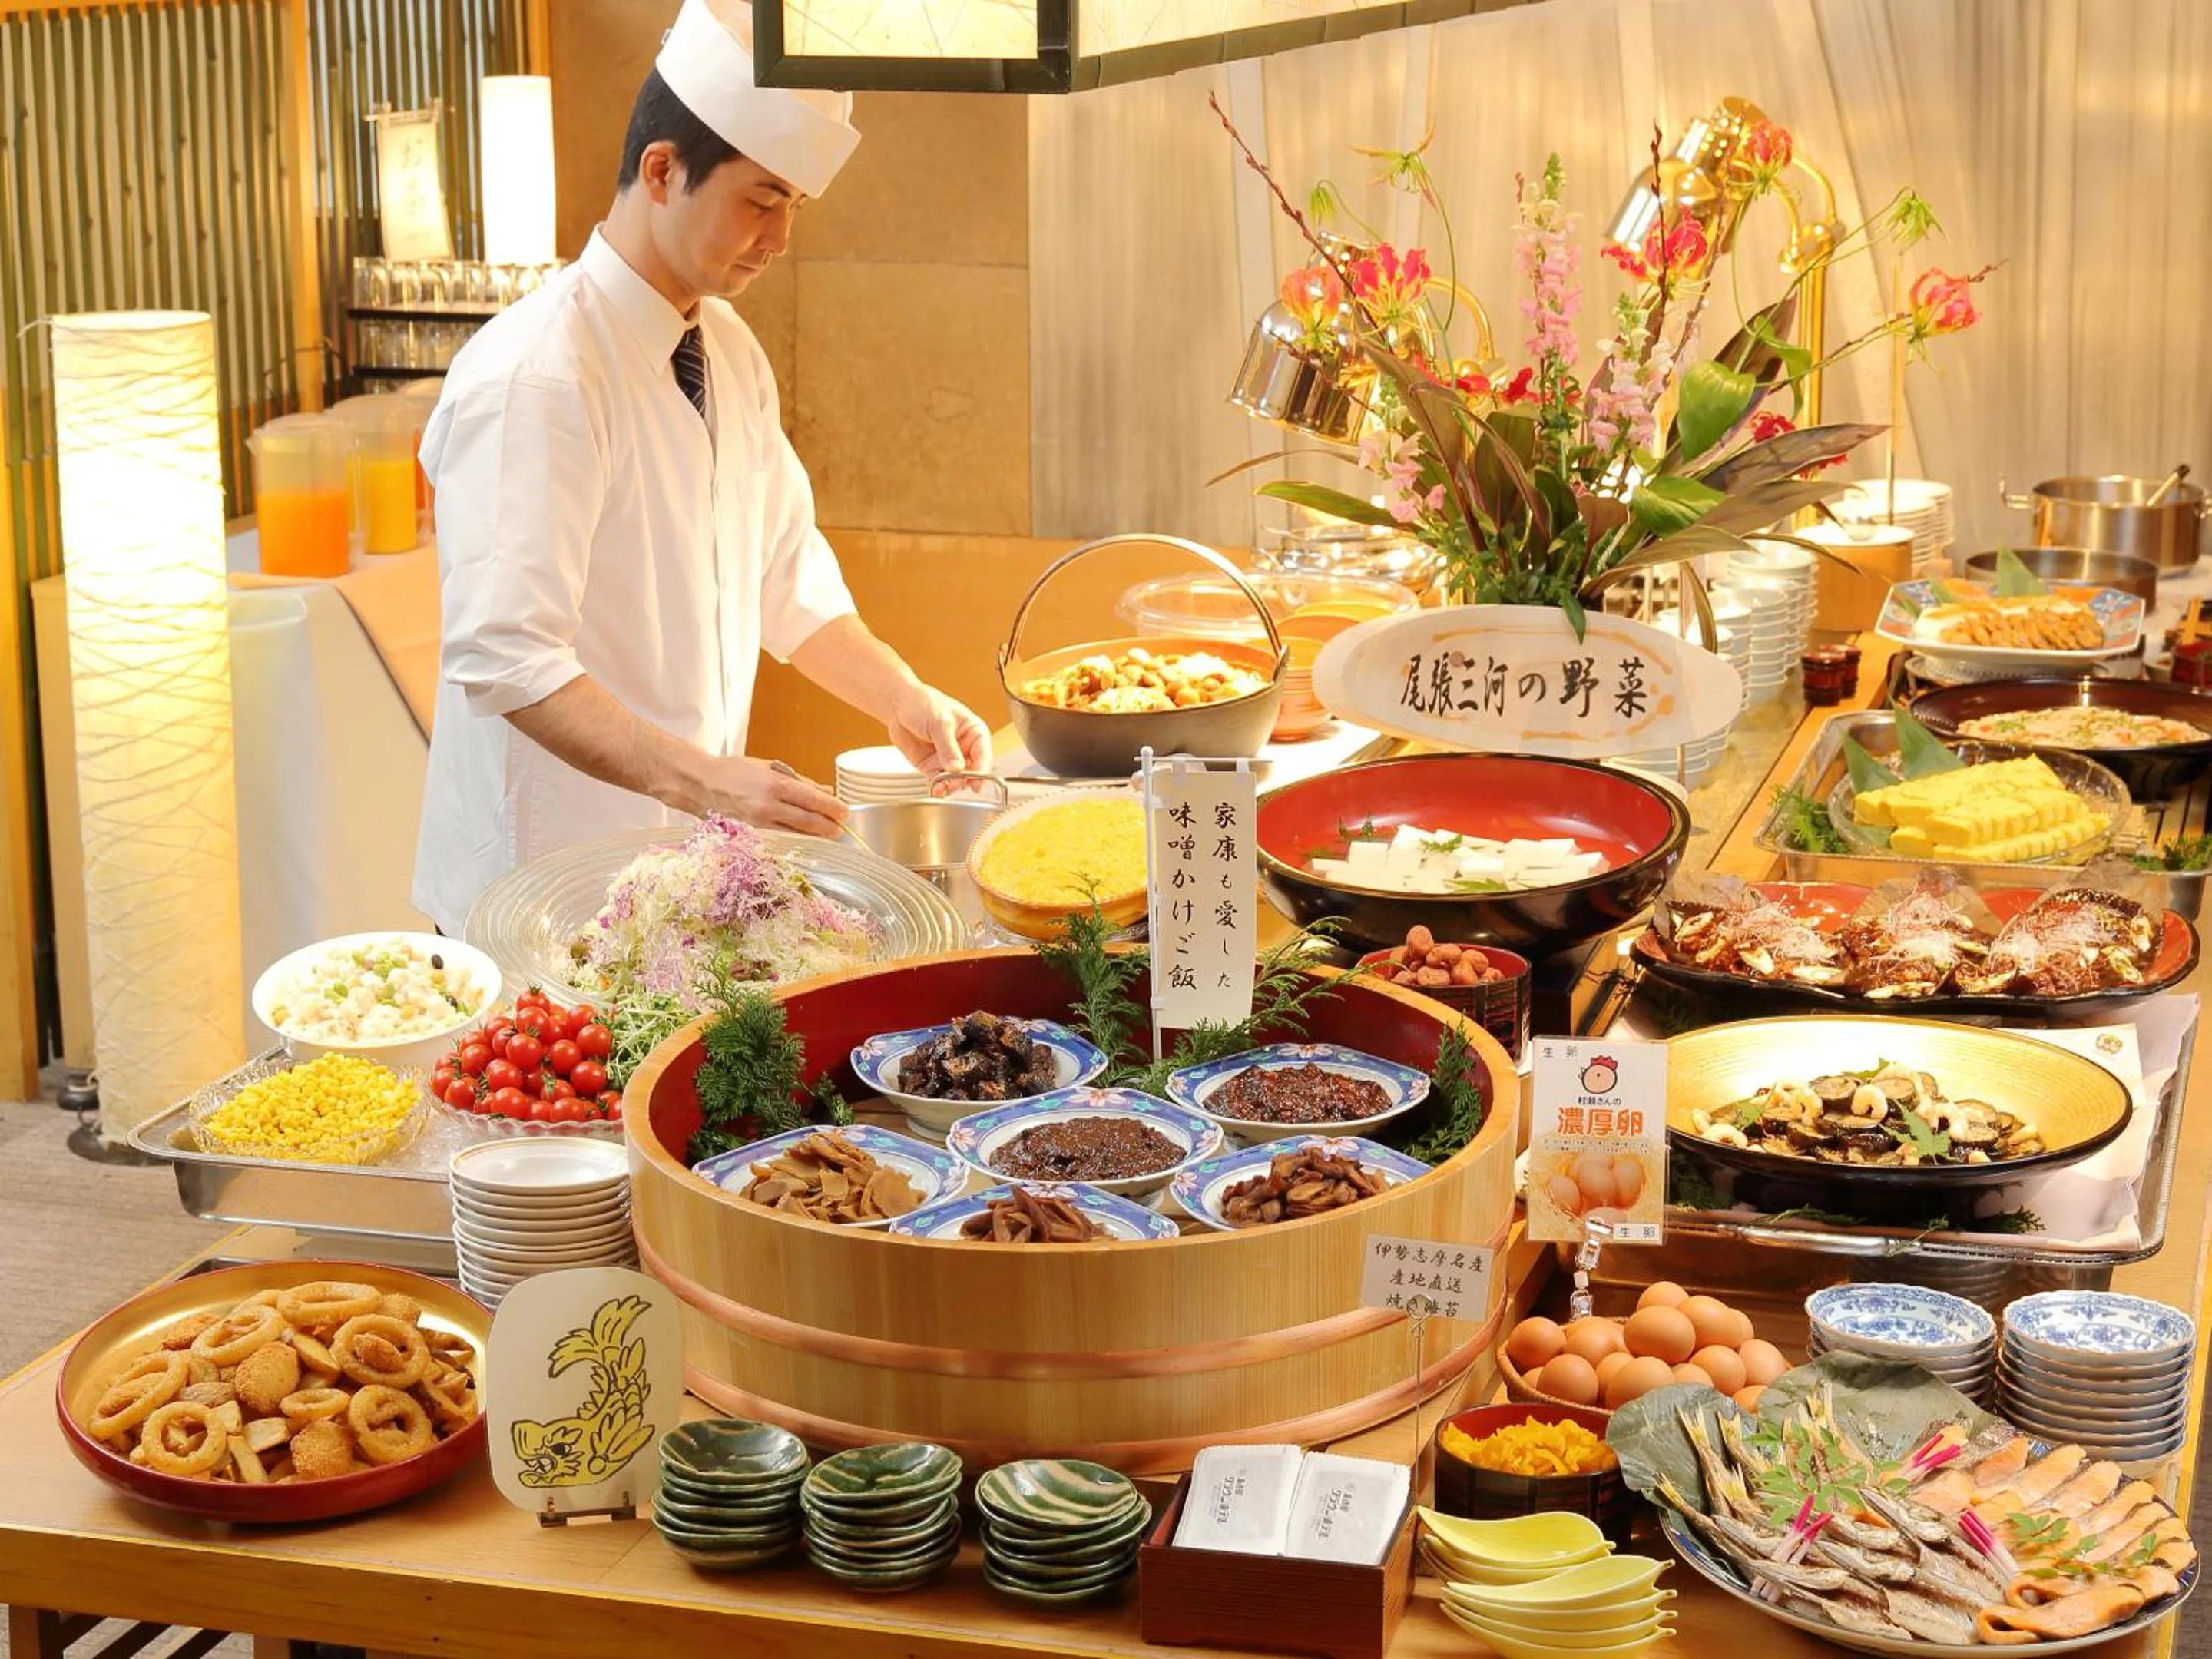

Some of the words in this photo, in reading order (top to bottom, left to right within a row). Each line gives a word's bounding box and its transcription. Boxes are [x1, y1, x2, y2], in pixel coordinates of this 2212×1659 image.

[1167, 801, 1197, 990] 味噌かけご飯
[1212, 801, 1239, 988] 家康も愛した
[1557, 1106, 1644, 1137] 濃厚卵
[1375, 1242, 1484, 1273] 伊勢志摩名産
[1389, 1267, 1463, 1294] 産地直送
